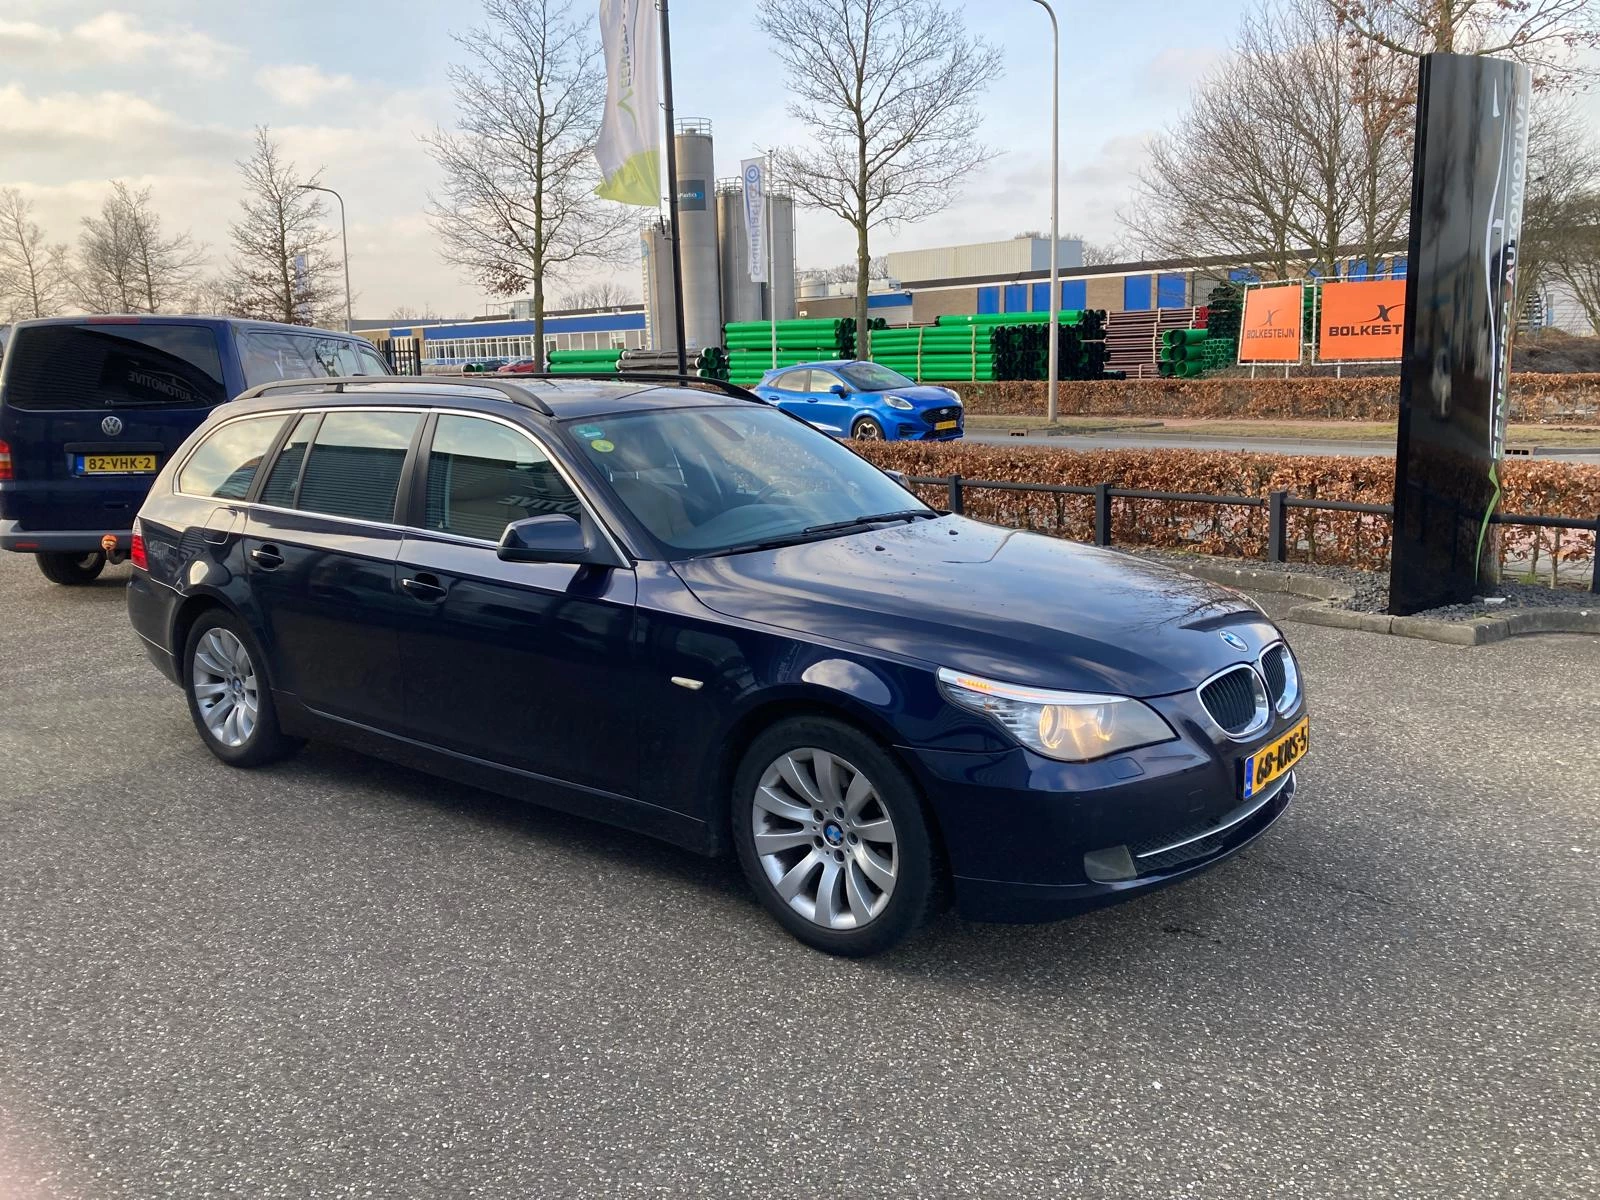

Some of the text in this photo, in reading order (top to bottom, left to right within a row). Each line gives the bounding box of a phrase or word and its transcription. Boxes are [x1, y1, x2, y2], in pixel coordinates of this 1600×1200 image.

[1504, 94, 1526, 285] AUTOMOTIVE
[1246, 327, 1295, 340] BOLKESTEIJN
[1328, 323, 1403, 337] BOLKEST
[88, 457, 151, 470] 82-VHK-2
